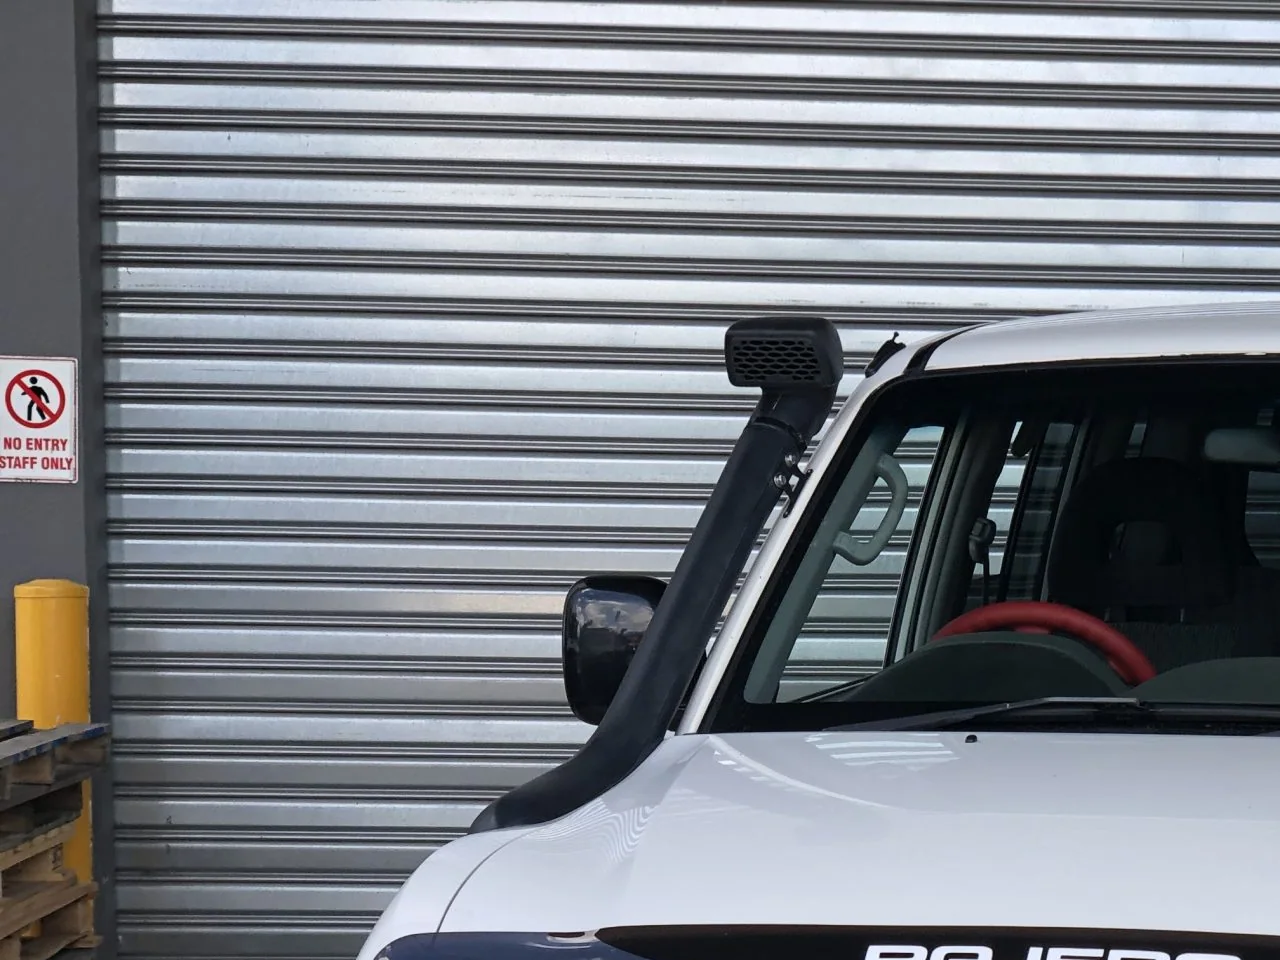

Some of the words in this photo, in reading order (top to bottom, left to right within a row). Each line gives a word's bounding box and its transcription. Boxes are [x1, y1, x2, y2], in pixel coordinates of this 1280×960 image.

[4, 437, 21, 450] NO
[26, 438, 68, 451] ENTRY
[0, 456, 37, 469] STAFF
[41, 457, 73, 470] ONLY
